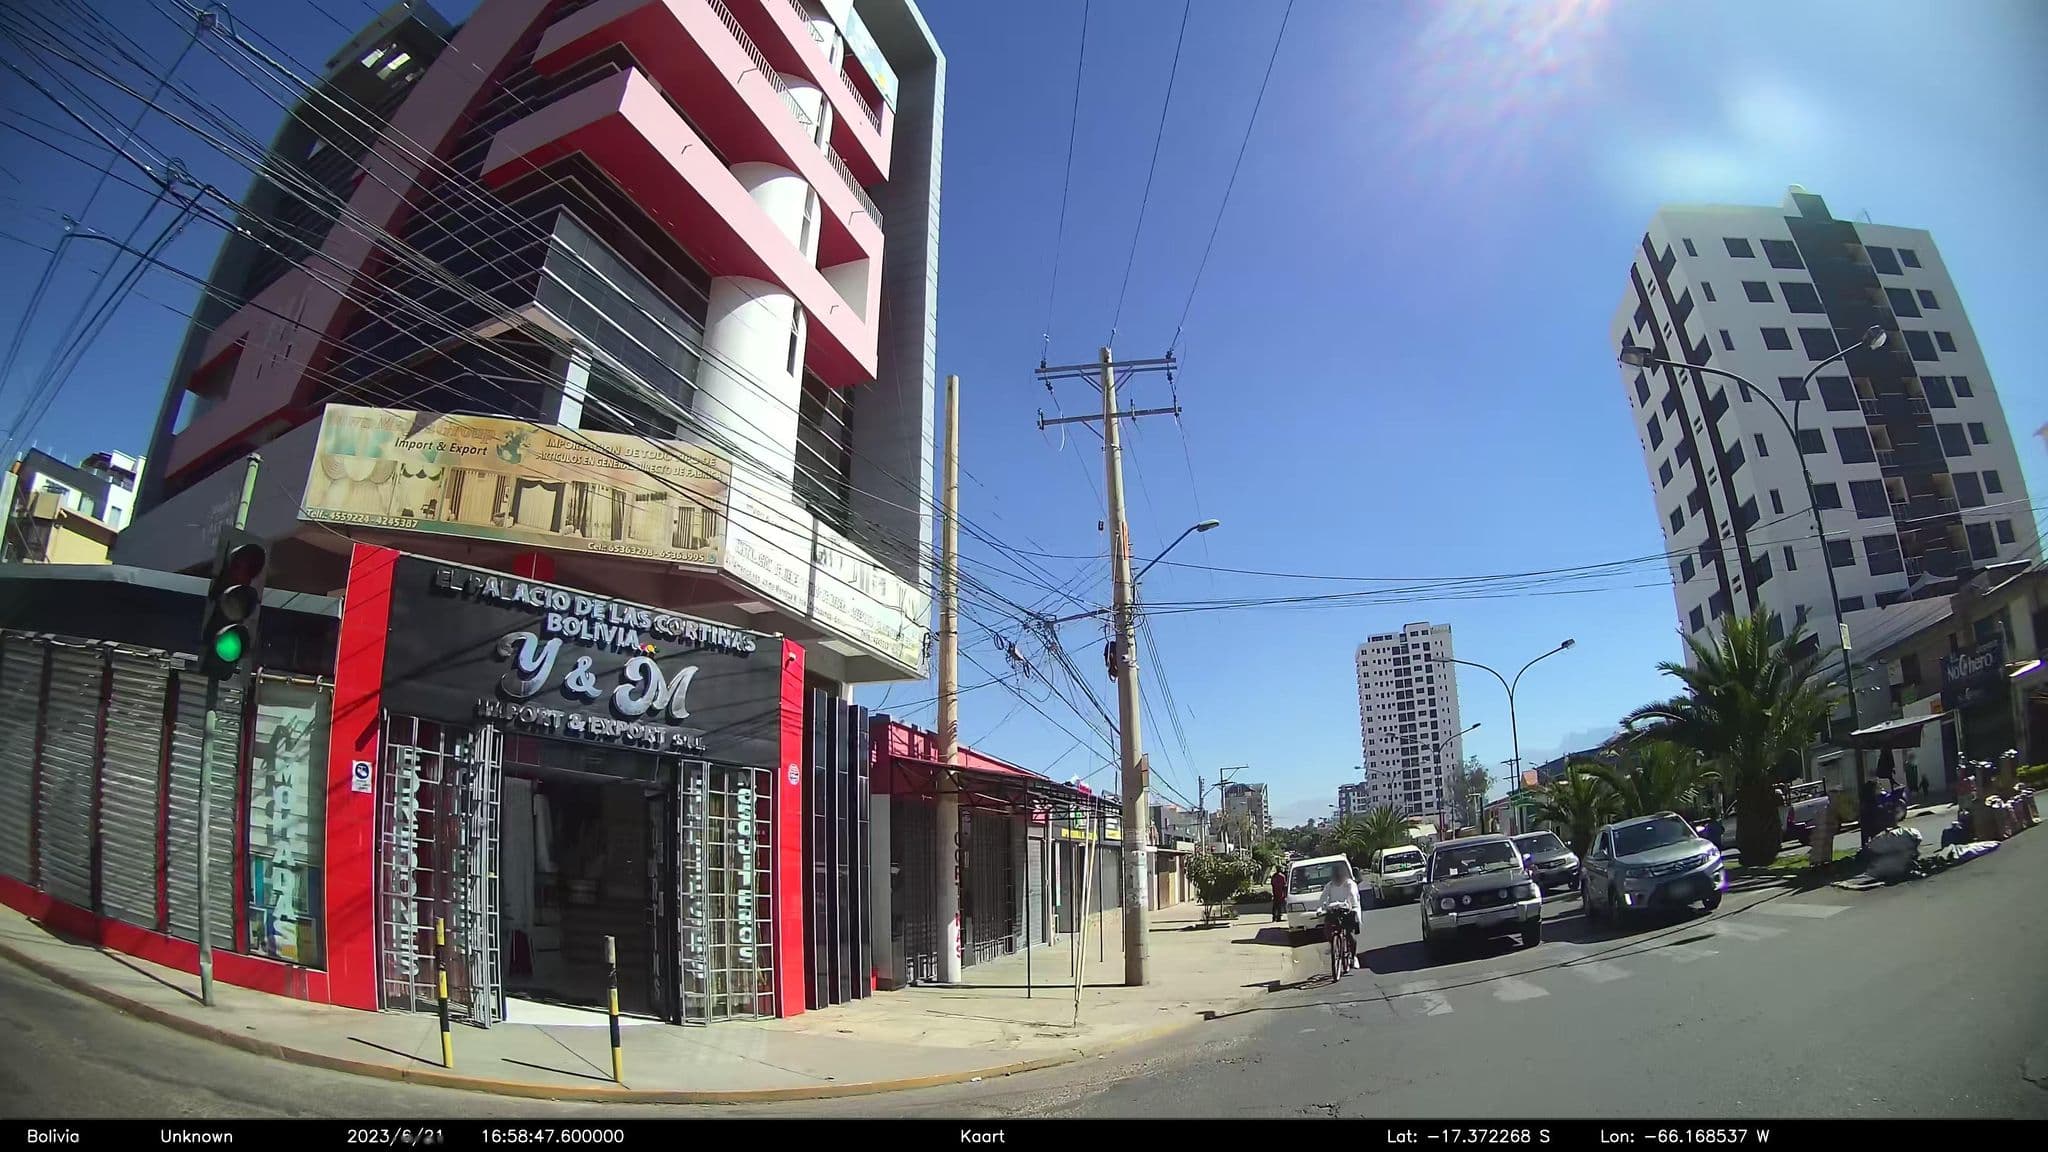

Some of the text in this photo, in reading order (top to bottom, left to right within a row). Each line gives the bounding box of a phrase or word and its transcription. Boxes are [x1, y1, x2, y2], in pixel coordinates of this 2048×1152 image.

[395, 437, 488, 457] Import & Export
[625, 448, 640, 458] DE
[582, 455, 596, 466] EN
[330, 511, 369, 524] 4559224
[377, 515, 419, 529] 4245387
[437, 568, 757, 652] EL PALACIO DE LAS CORTINAS
[546, 612, 641, 650] BOLIVIA
[564, 655, 603, 698] &
[614, 656, 699, 719] M
[567, 713, 586, 732] &
[588, 715, 666, 745] EXPORT
